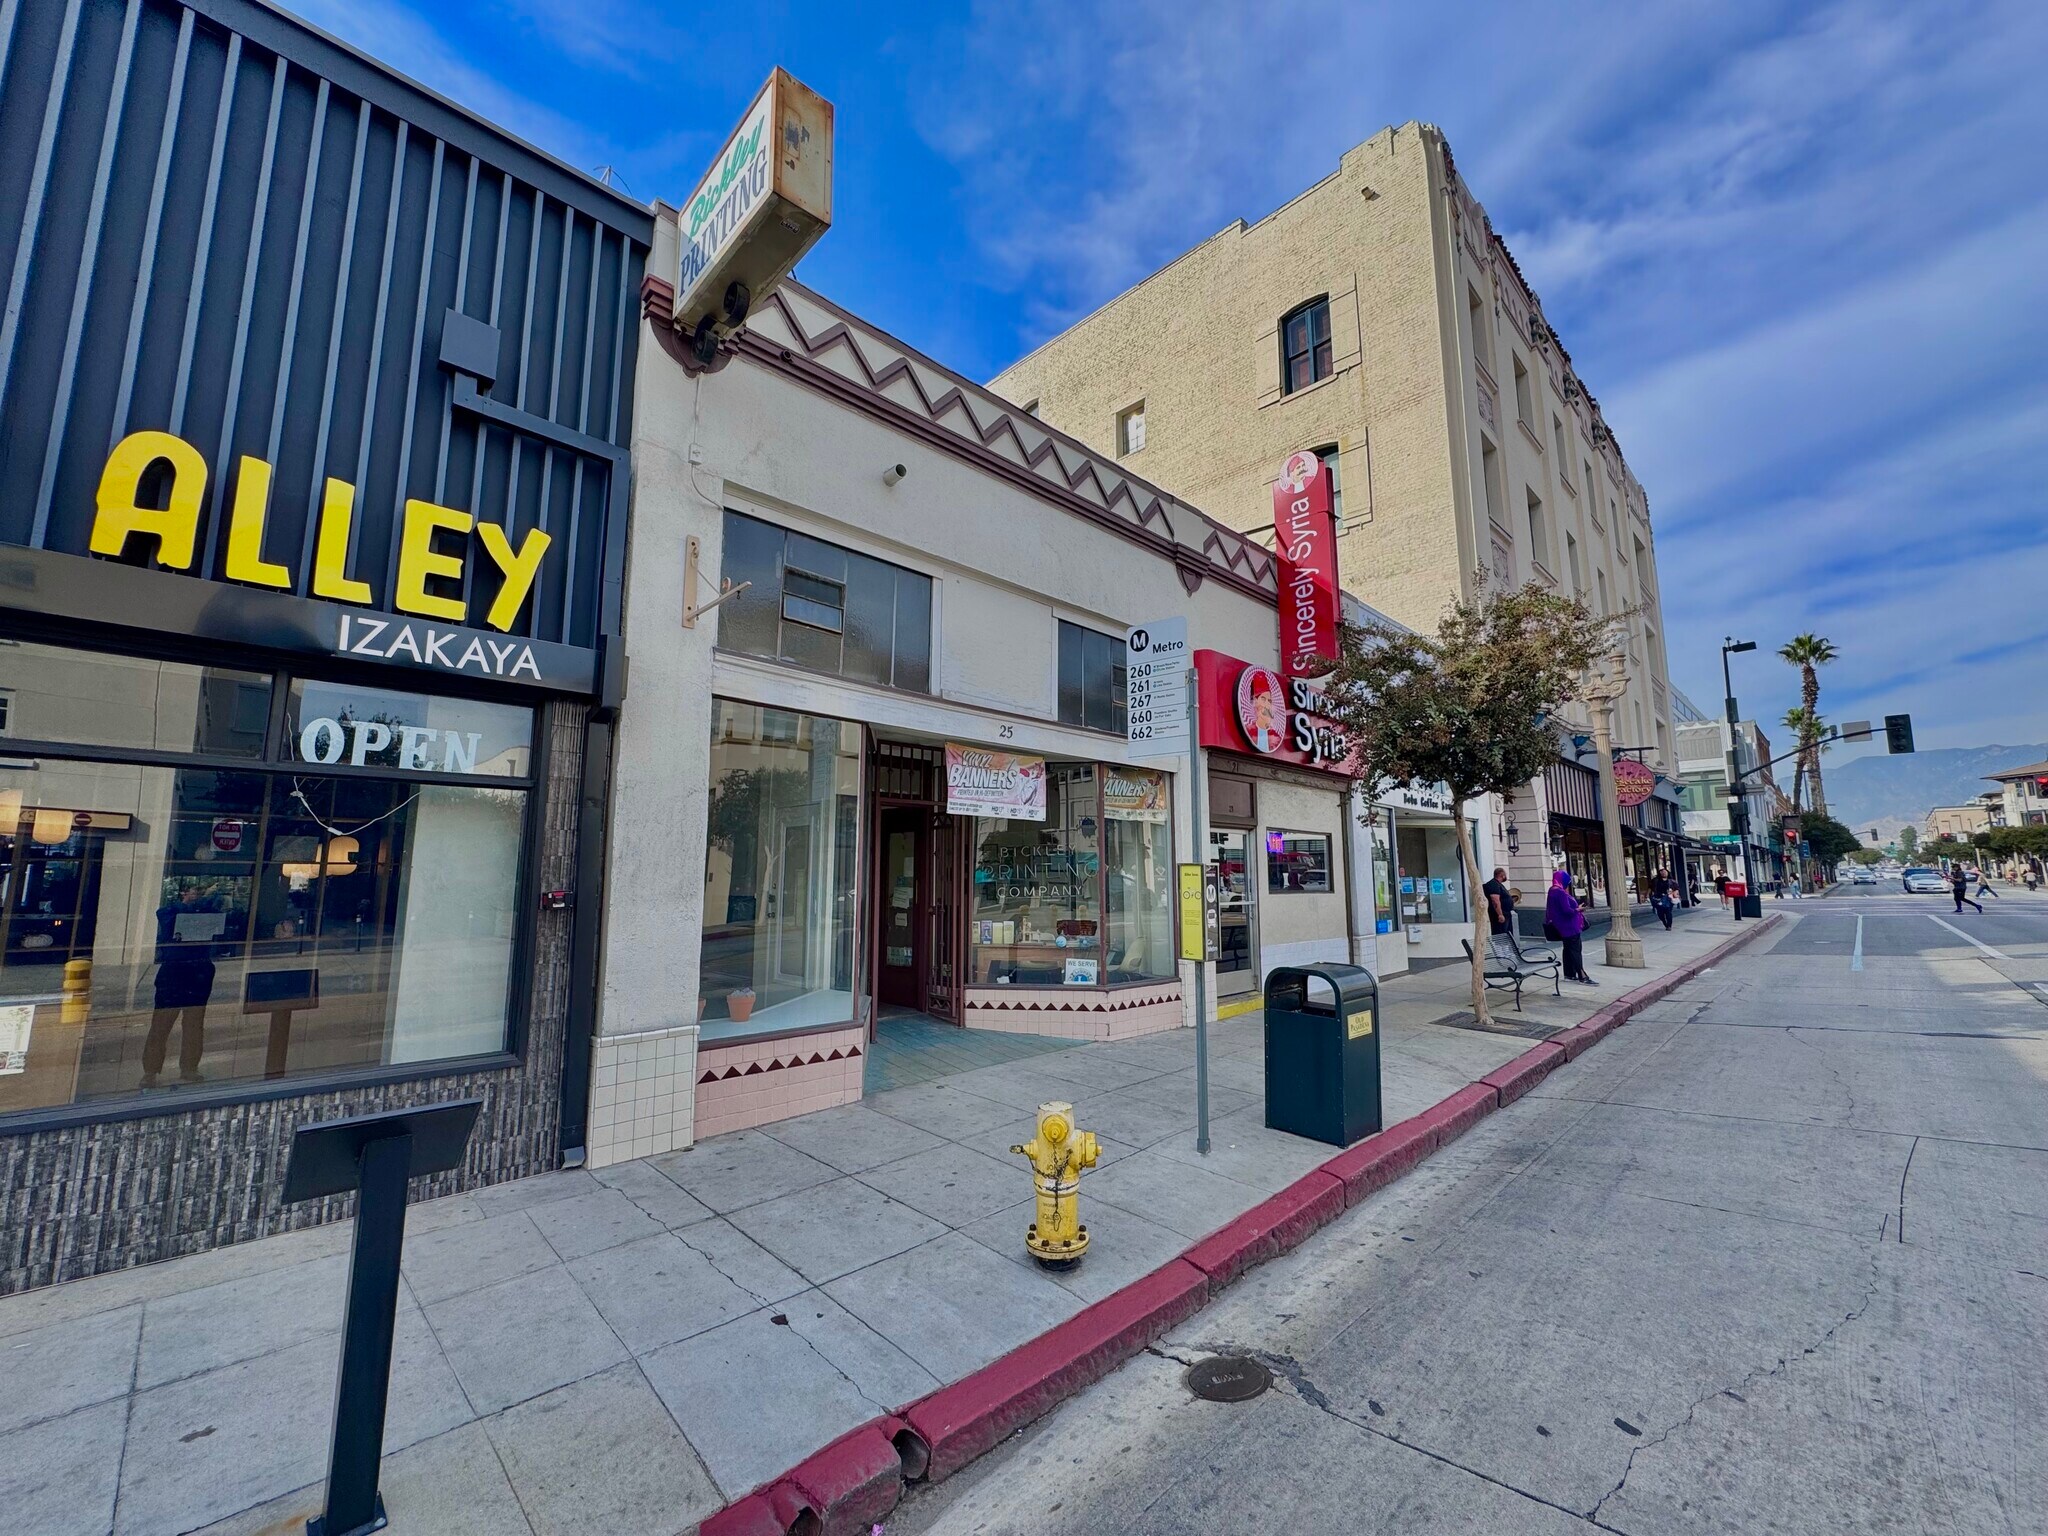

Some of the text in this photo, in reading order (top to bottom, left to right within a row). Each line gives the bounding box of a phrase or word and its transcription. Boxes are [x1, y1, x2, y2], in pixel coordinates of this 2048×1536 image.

[689, 114, 765, 241] Bickley
[679, 145, 767, 299] PRINTING
[90, 430, 551, 632] ALLEY
[1287, 496, 1320, 672] Sincerely Syria
[338, 614, 541, 681] IZAKAYA
[1152, 640, 1183, 654] Metro
[1130, 664, 1151, 679] 260
[1130, 680, 1150, 694] 261
[1130, 694, 1151, 709] 267
[1131, 710, 1151, 724] 660
[999, 725, 1013, 739] 25
[1131, 726, 1151, 740] 662
[300, 717, 482, 775] OPEN
[962, 750, 993, 768] VINYL
[948, 763, 1017, 790] BANNERS
[1104, 779, 1147, 797] ANNERS
[1000, 844, 1076, 858] BICKLEY
[997, 885, 1083, 898] COMPANY
